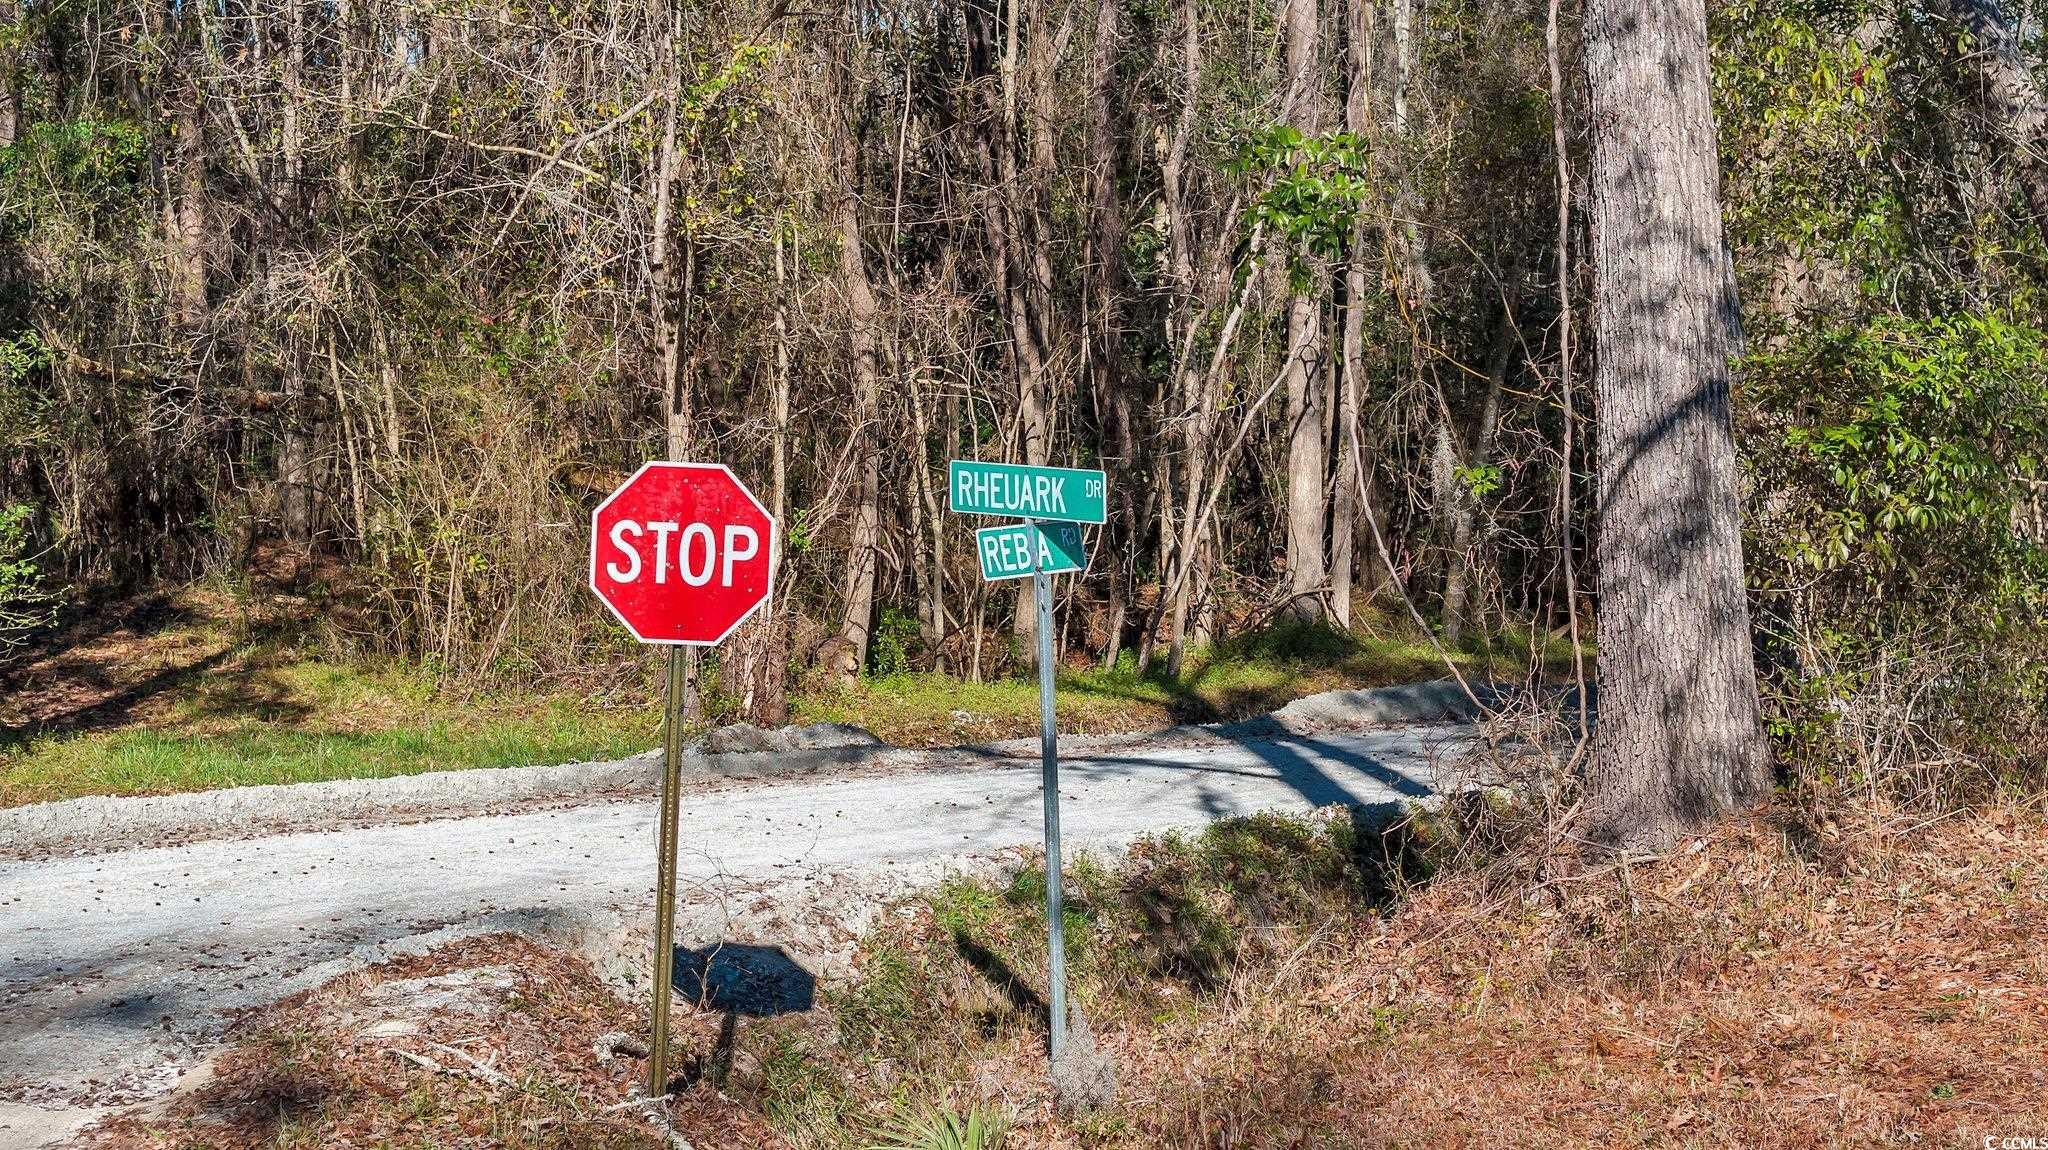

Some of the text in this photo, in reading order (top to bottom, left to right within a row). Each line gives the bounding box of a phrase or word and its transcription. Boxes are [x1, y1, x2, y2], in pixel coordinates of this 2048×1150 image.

[958, 470, 1102, 513] RHEUARK DR
[606, 519, 759, 587] STOP
[1061, 528, 1077, 547] RD
